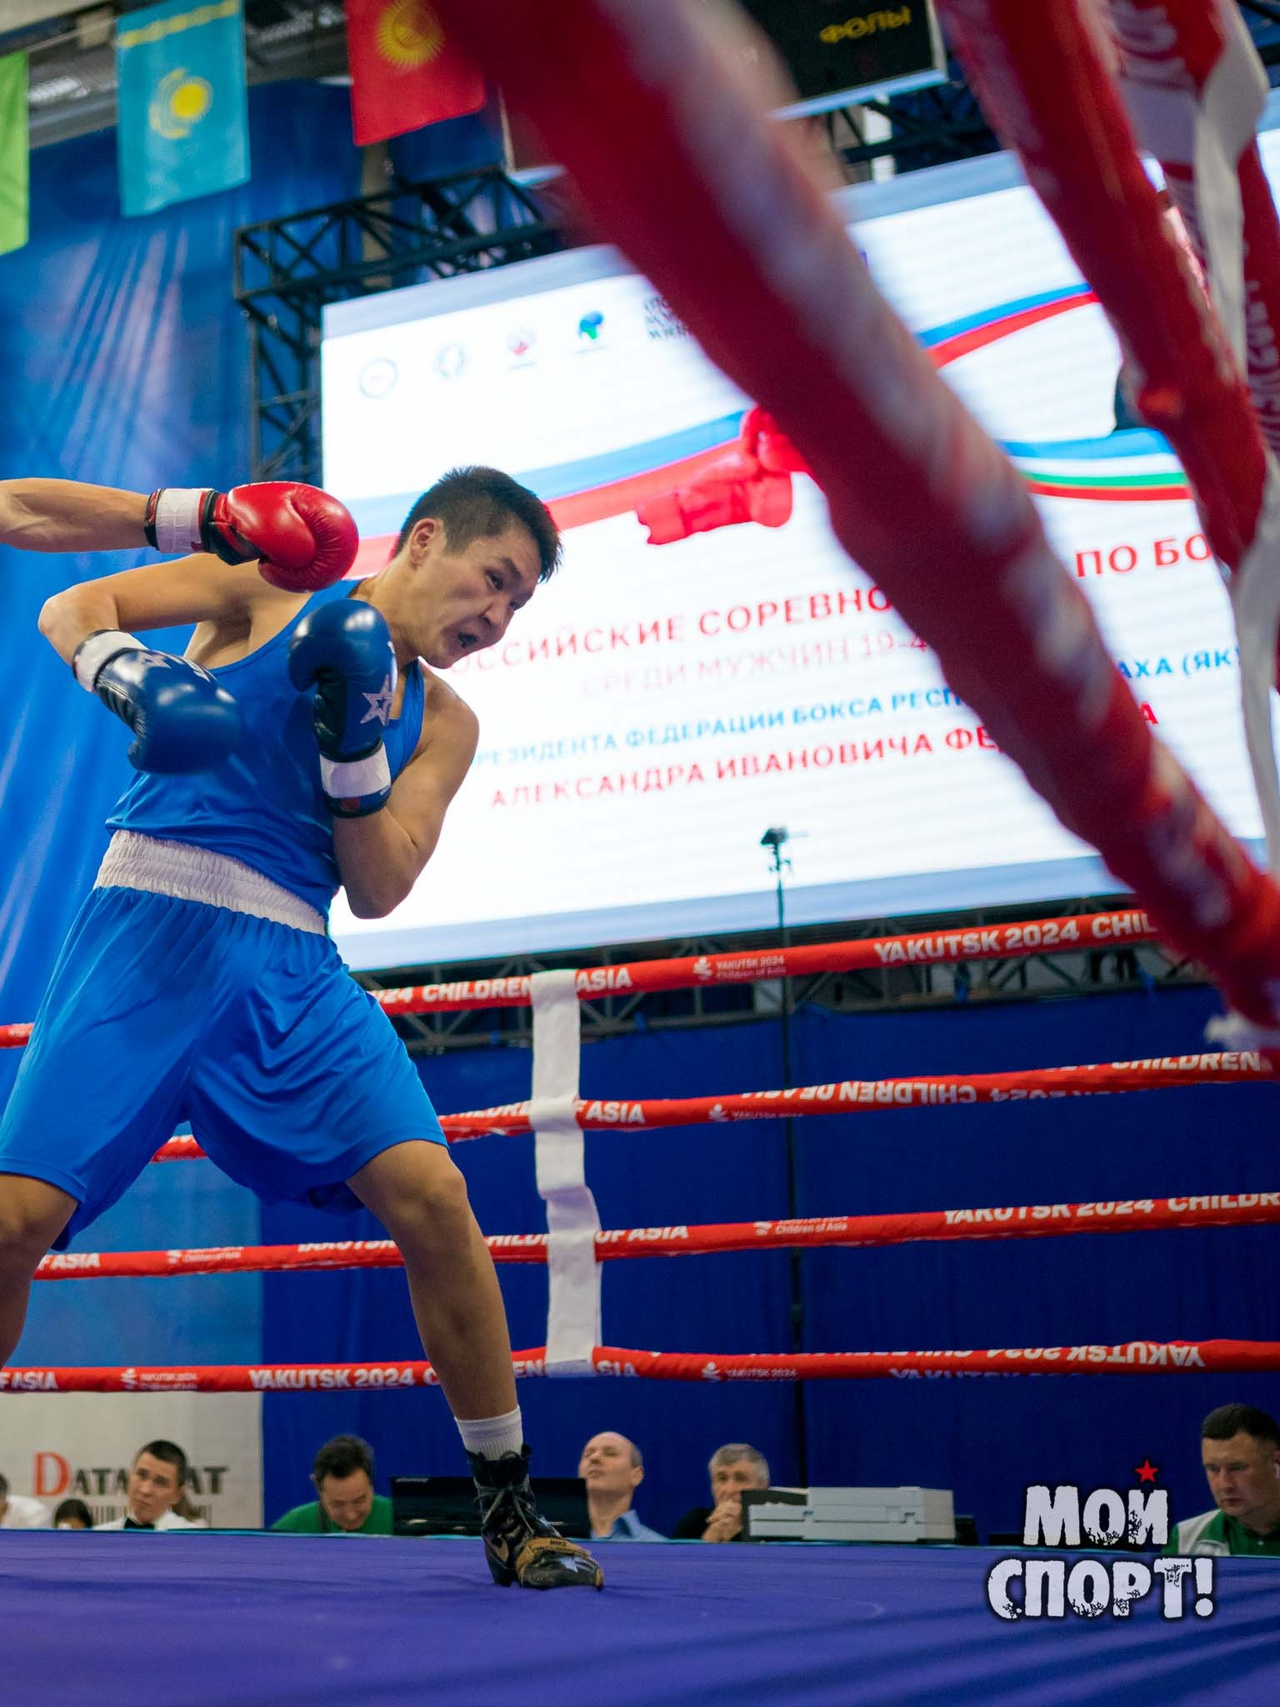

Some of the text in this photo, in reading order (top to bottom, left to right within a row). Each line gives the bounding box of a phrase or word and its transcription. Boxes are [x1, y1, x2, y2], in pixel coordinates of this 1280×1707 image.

[819, 5, 911, 43] ФОЛЫ
[448, 615, 686, 675] ОССИЙСКИЕ
[1075, 545, 1138, 578] ПО
[1153, 532, 1214, 567] БО
[696, 637, 850, 681] МУЖЧИН
[862, 631, 928, 658] 19-4
[475, 732, 618, 768] РЕЗИДЕНТА
[625, 710, 785, 749] ФЕДЕРАЦИИ
[793, 696, 884, 725] БОКСА
[891, 686, 962, 712] РЕСП
[1118, 657, 1174, 680] АХА
[491, 762, 705, 808] АЛЕКСАНДРА
[716, 732, 933, 781] ИВАНОВИЧА
[874, 911, 1158, 964] YAKUTSK 2024 CHIL
[574, 968, 632, 991] ASIA
[839, 1080, 977, 1104] CHILDREN
[586, 1100, 645, 1124] ASIA
[1075, 1198, 1155, 1218] 2024
[48, 1253, 101, 1271] ASIA
[1066, 1341, 1206, 1368] YAKUTSK
[11, 1373, 58, 1391] ASIA
[248, 1369, 352, 1390] YAKUTSK
[354, 1367, 415, 1388] 2024
